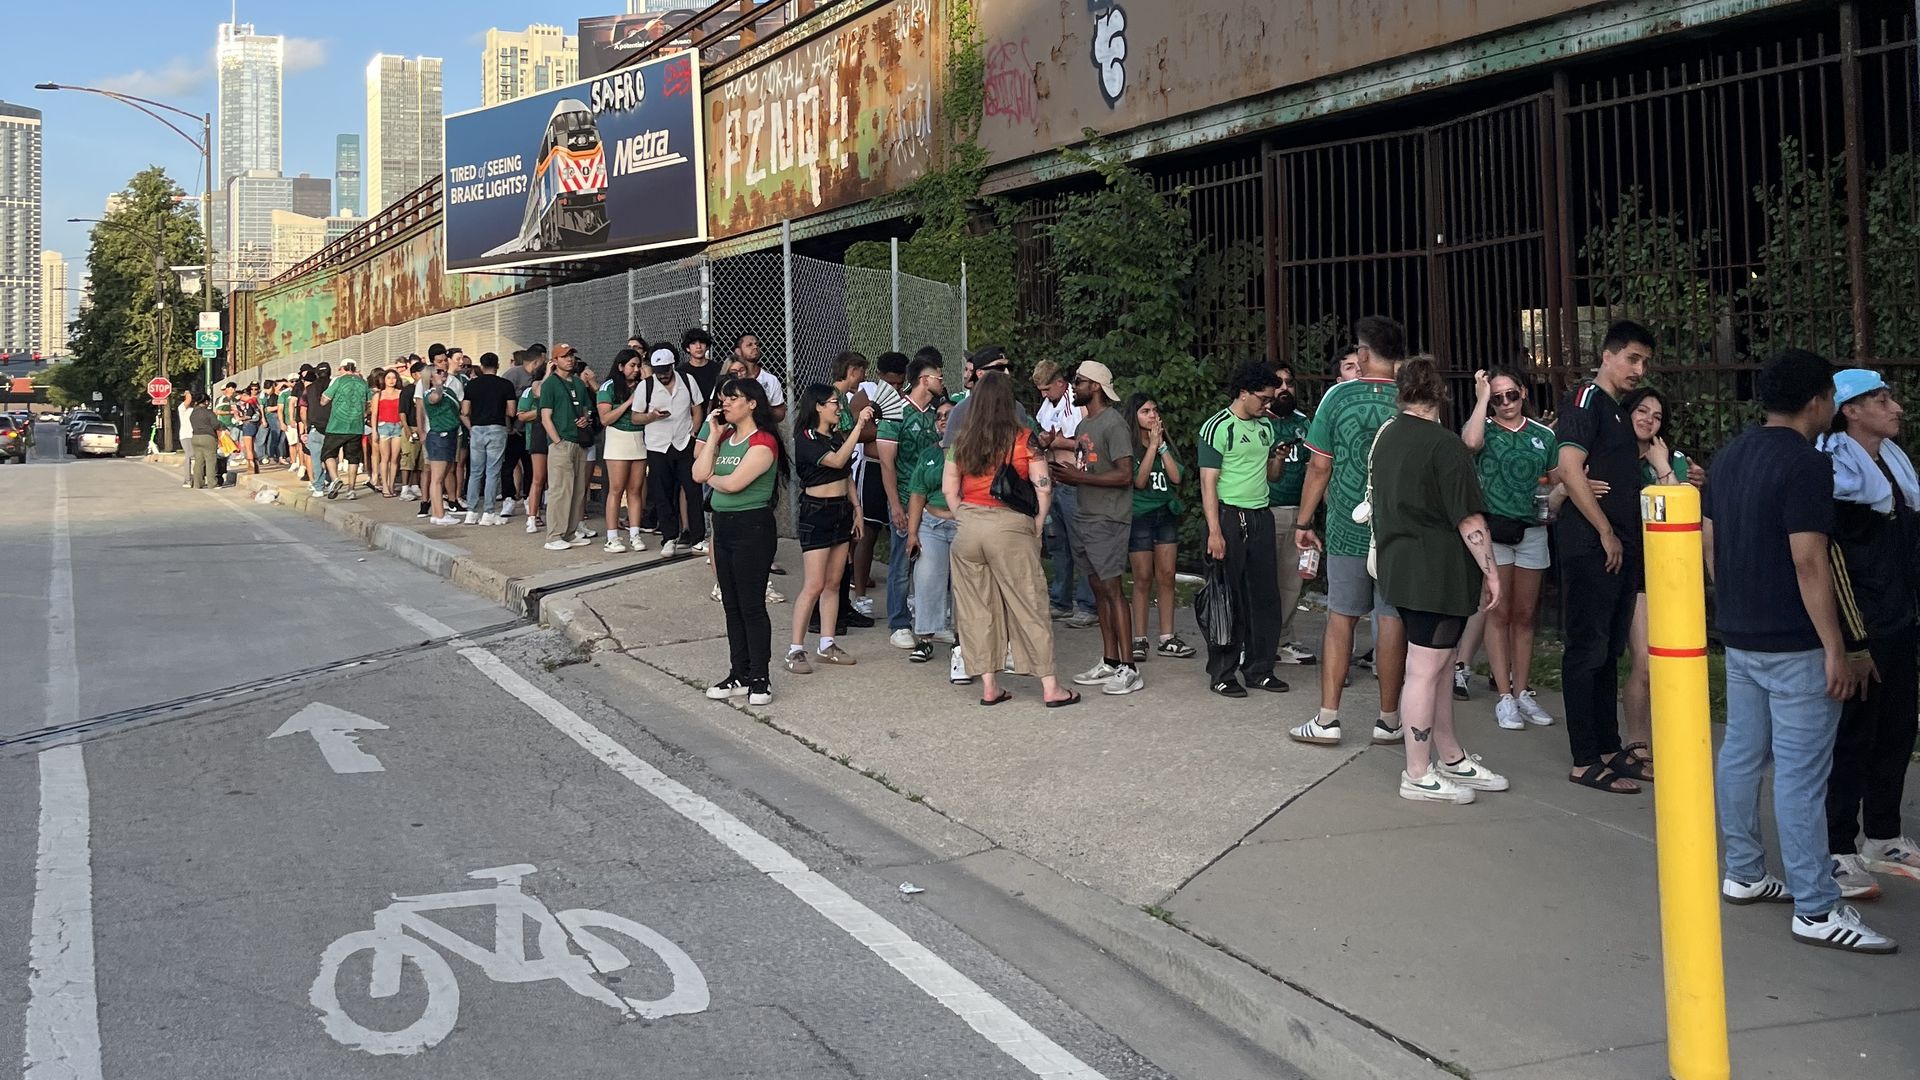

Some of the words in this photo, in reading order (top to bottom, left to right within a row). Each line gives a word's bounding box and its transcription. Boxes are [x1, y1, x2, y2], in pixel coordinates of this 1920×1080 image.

[619, 41, 645, 51] potential
[613, 129, 671, 177] Metra
[450, 164, 476, 183] TIRED
[478, 161, 487, 182] of
[487, 154, 522, 177] SEEING
[451, 183, 484, 204] BRAKE
[486, 174, 528, 199] LIGHTS?
[150, 384, 170, 393] STOP
[715, 456, 741, 466] EXICO
